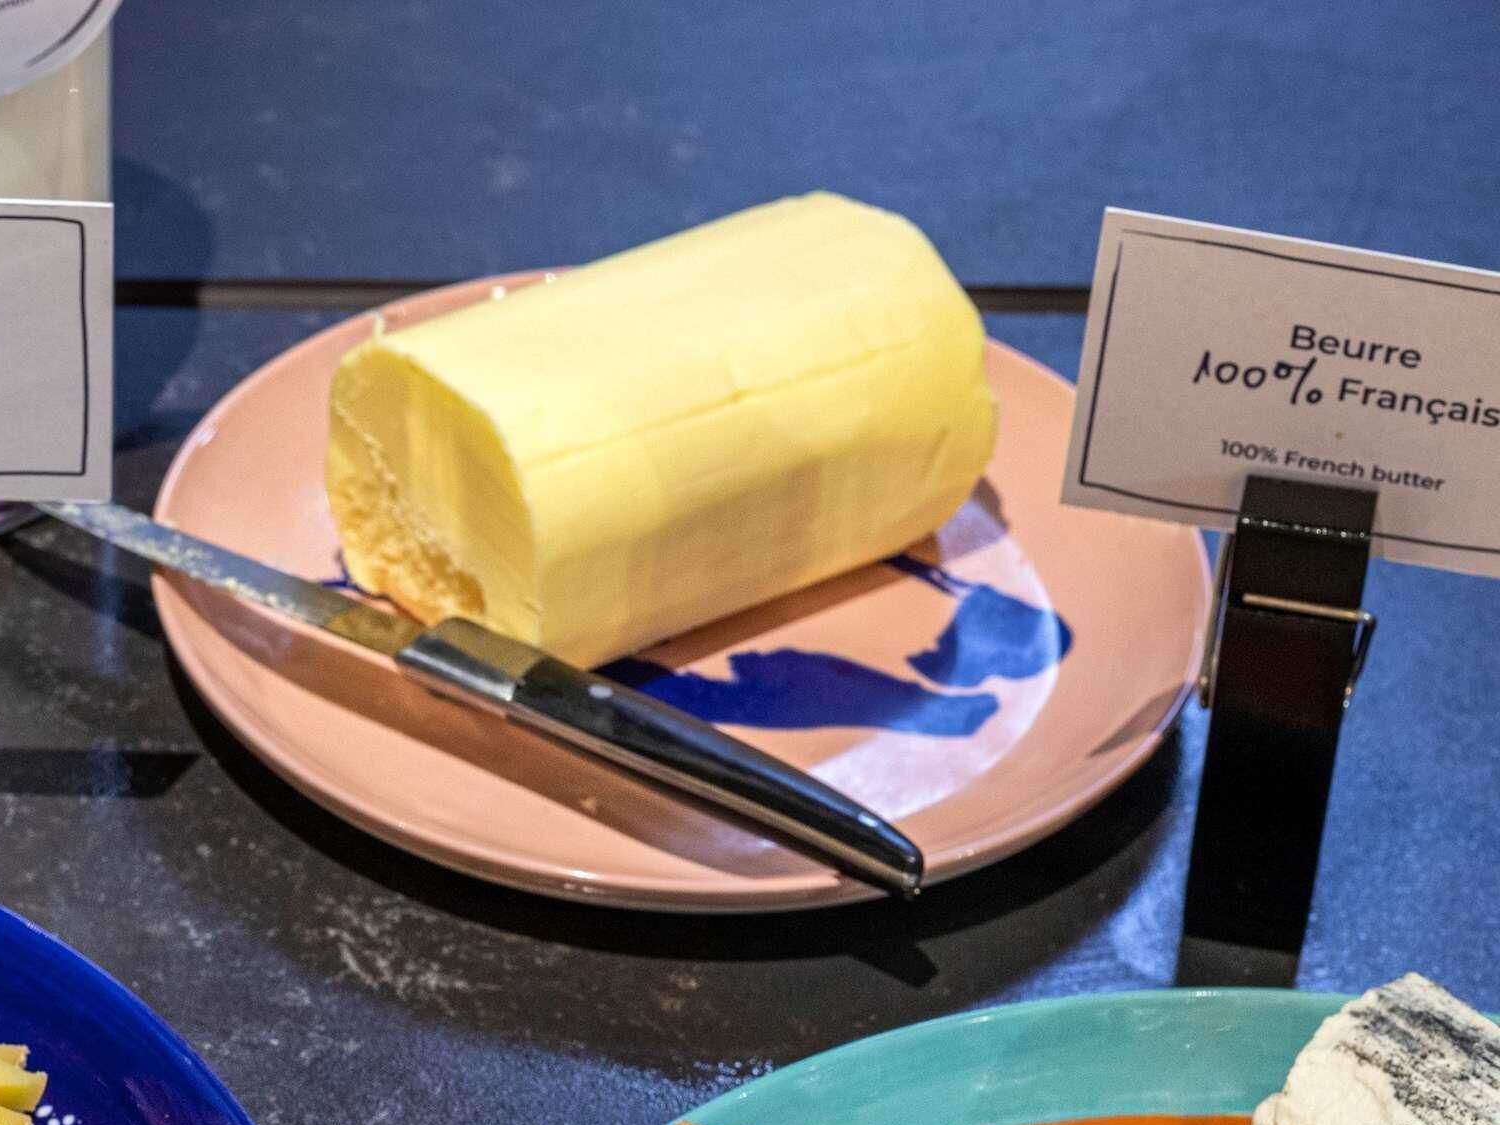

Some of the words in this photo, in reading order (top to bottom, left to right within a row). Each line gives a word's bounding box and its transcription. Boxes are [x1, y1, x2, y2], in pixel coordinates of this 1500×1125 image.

[1290, 324, 1422, 369] Beurre
[1193, 350, 1323, 405] 100%
[1338, 378, 1500, 427] Français
[1221, 438, 1278, 464] 100%
[1283, 450, 1365, 479] French
[1371, 464, 1445, 492] butter
